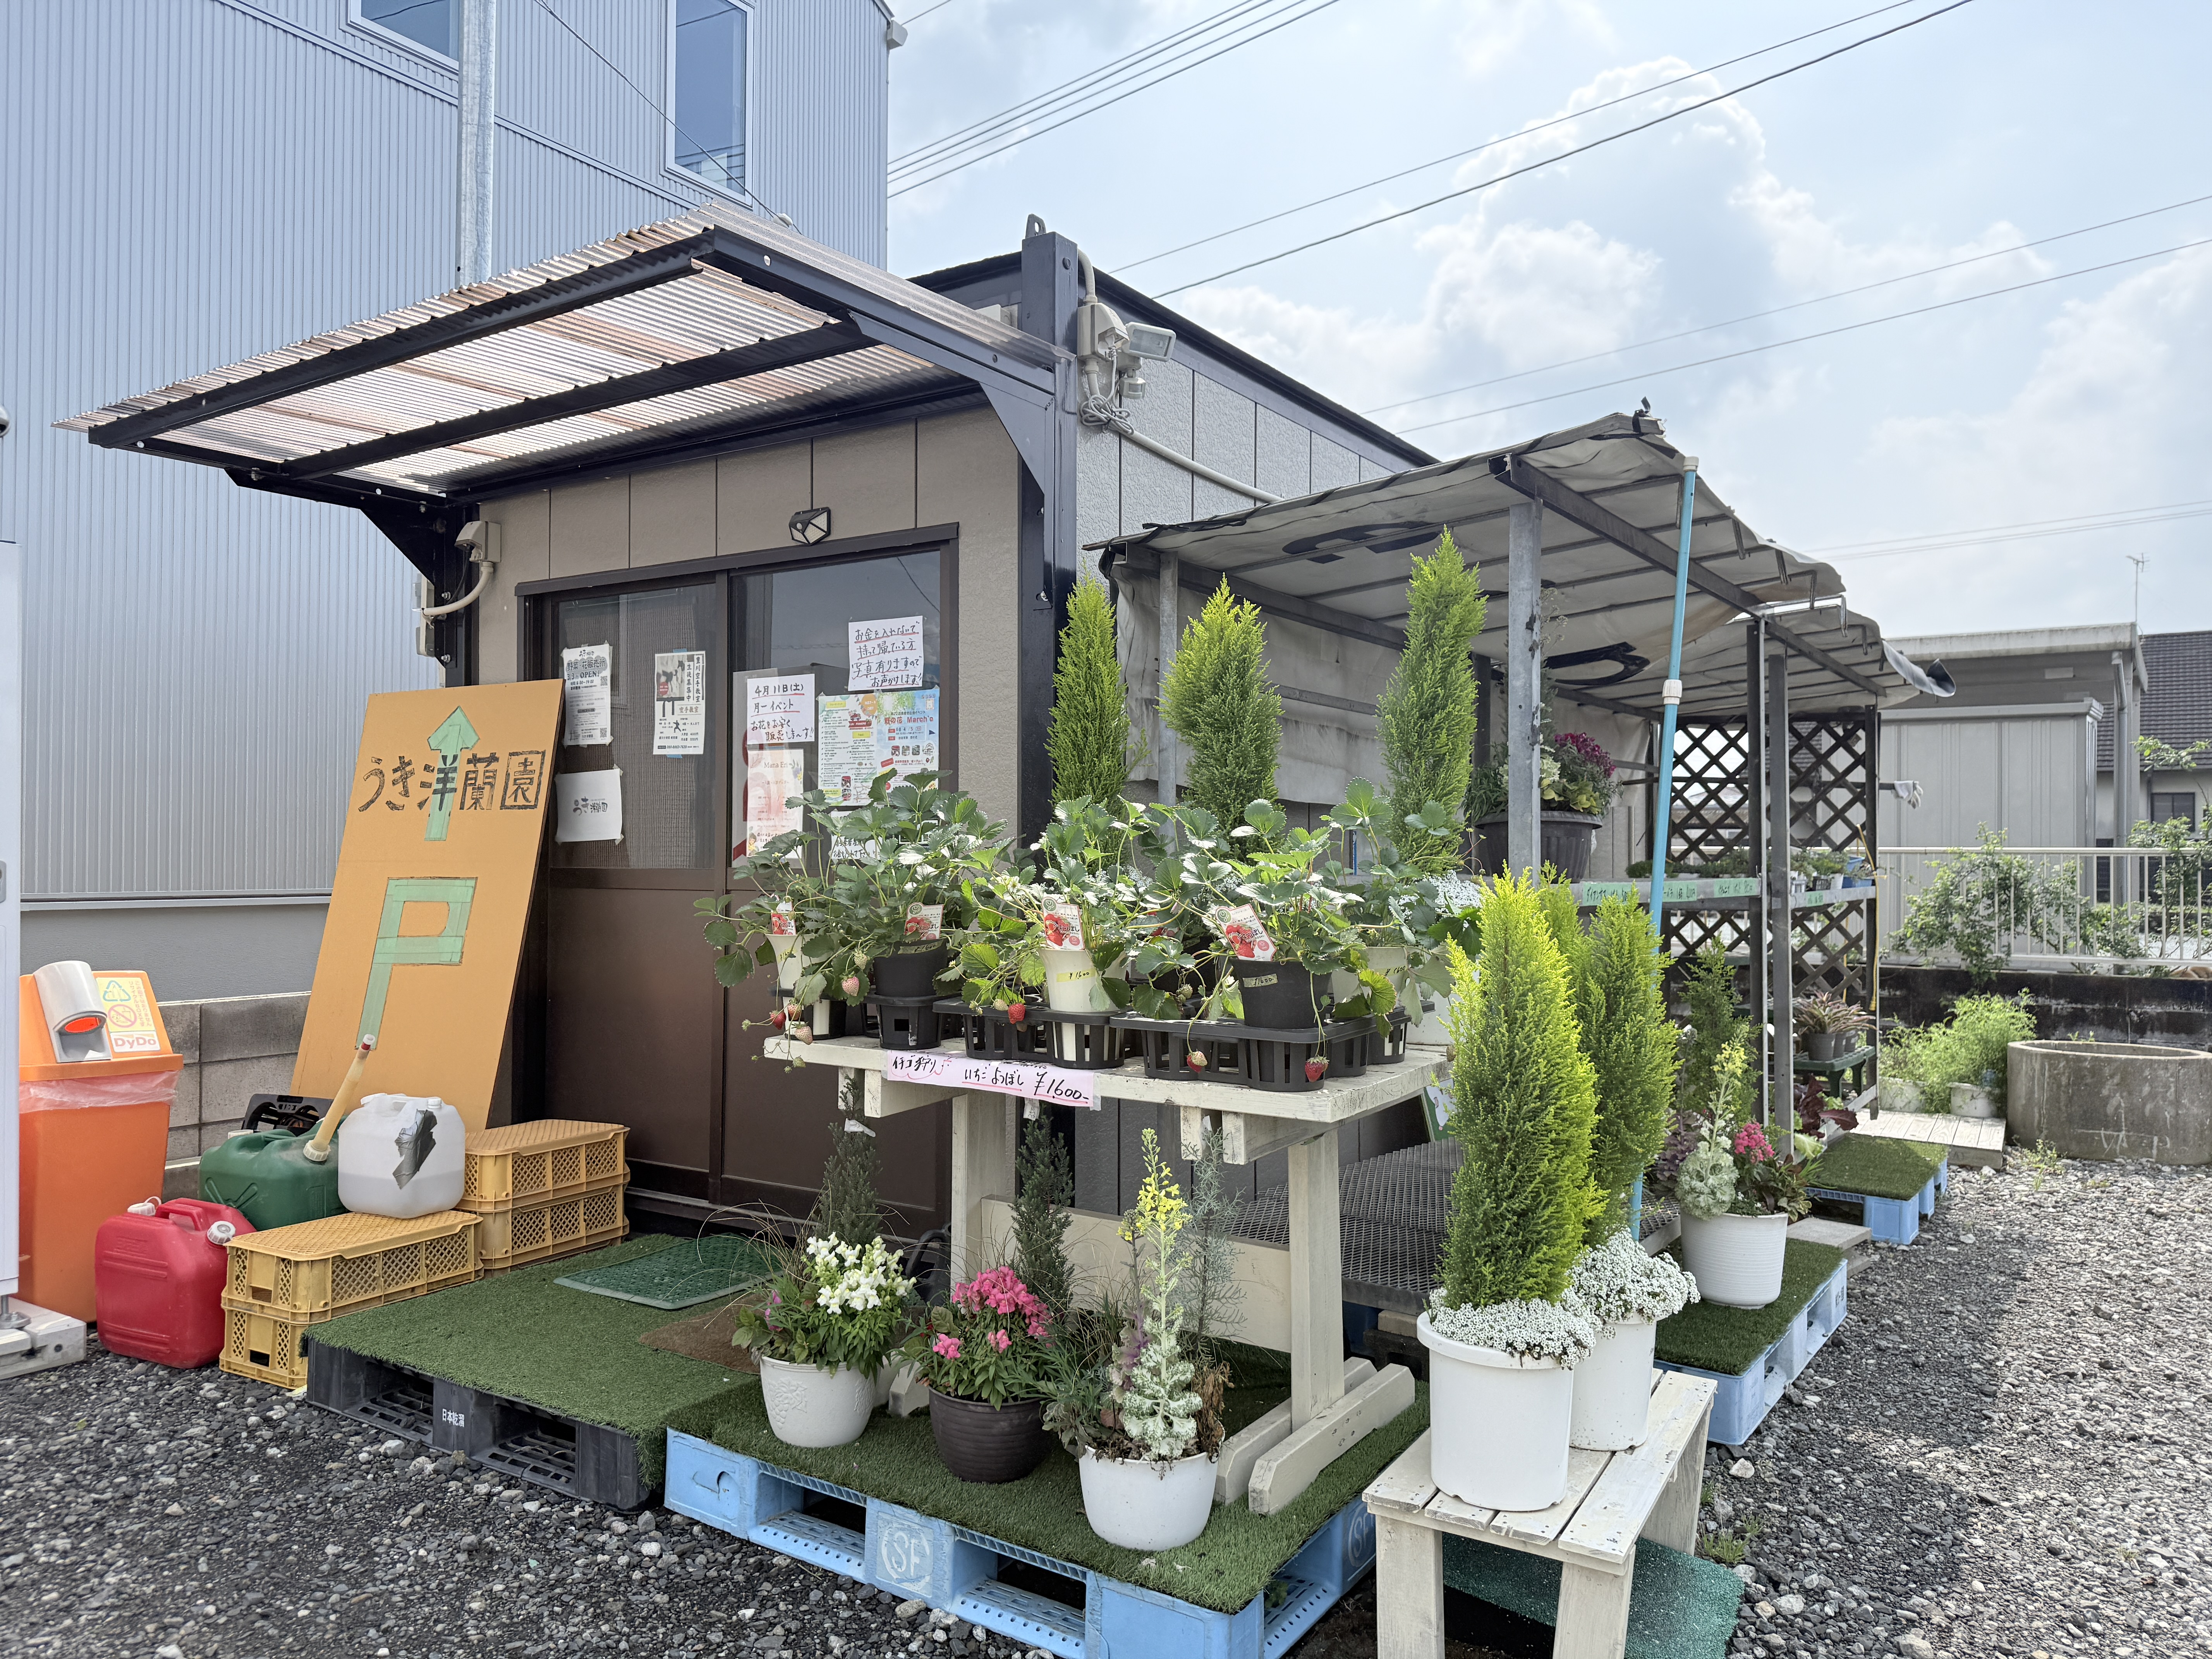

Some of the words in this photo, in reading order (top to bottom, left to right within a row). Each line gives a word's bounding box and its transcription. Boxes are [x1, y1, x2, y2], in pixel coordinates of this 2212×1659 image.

[856, 638, 915, 658] 持って帰っている方
[751, 716, 790, 731] お花をお安く
[359, 750, 546, 811] うき洋蘭園
[355, 877, 478, 1050] P
[114, 1037, 156, 1049] DyDo
